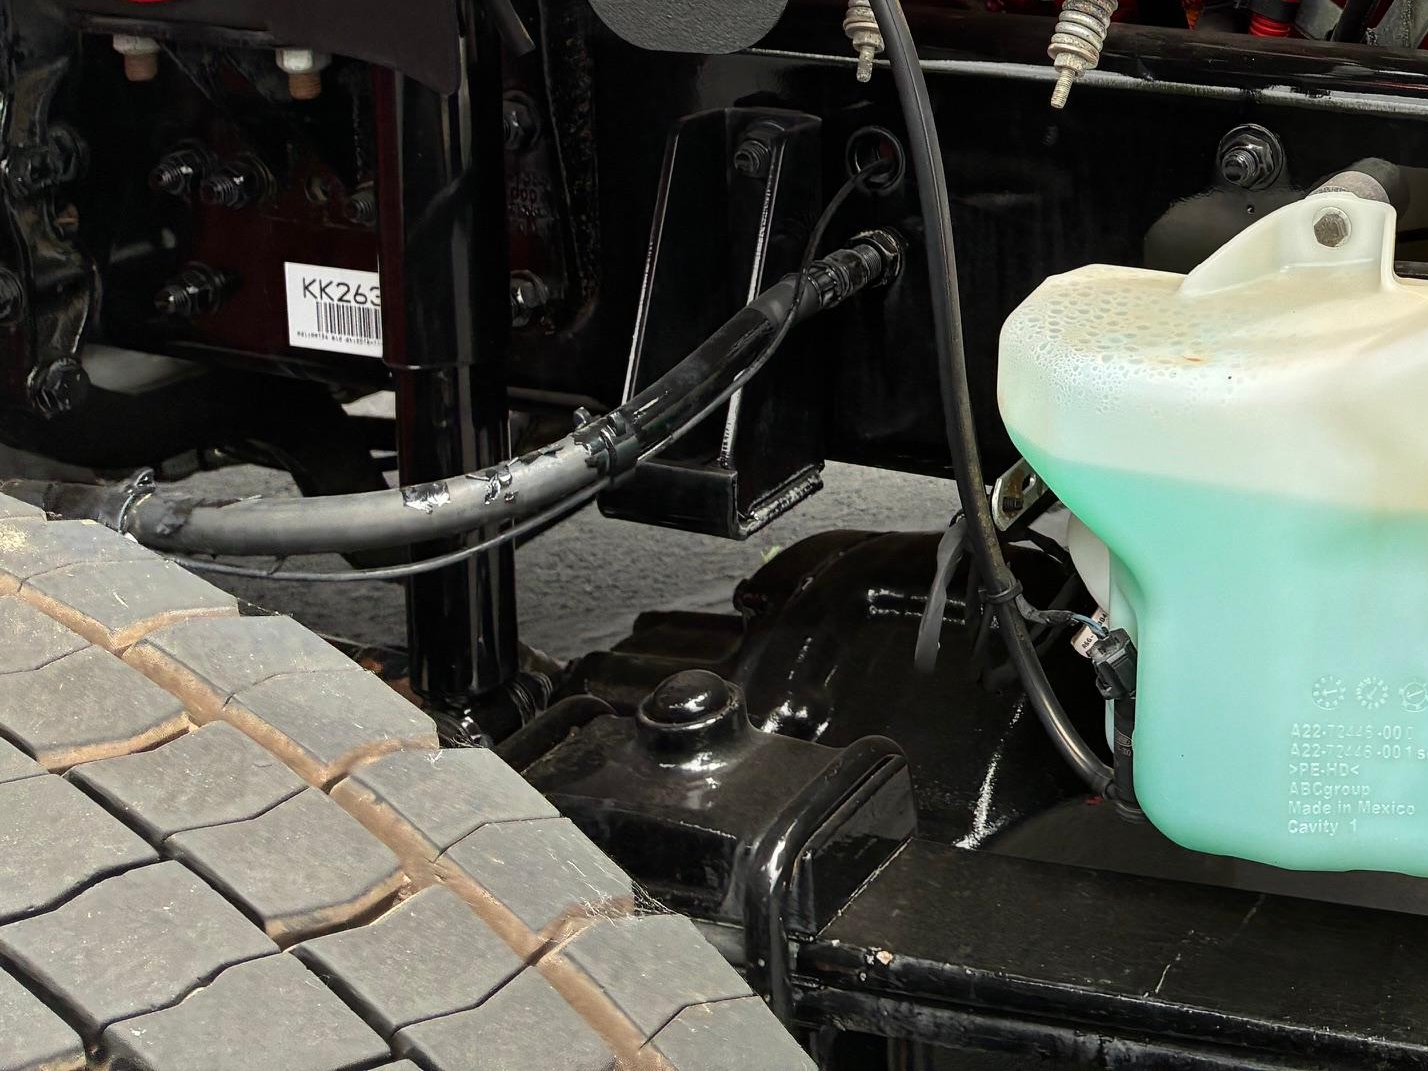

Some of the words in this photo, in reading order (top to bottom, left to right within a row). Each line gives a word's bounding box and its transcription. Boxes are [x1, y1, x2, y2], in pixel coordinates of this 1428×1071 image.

[1288, 800, 1332, 815] Made
[1338, 800, 1352, 814] in
[1358, 800, 1416, 816] Mexico
[1287, 819, 1340, 837] Cavity
[1349, 818, 1357, 833] 1
